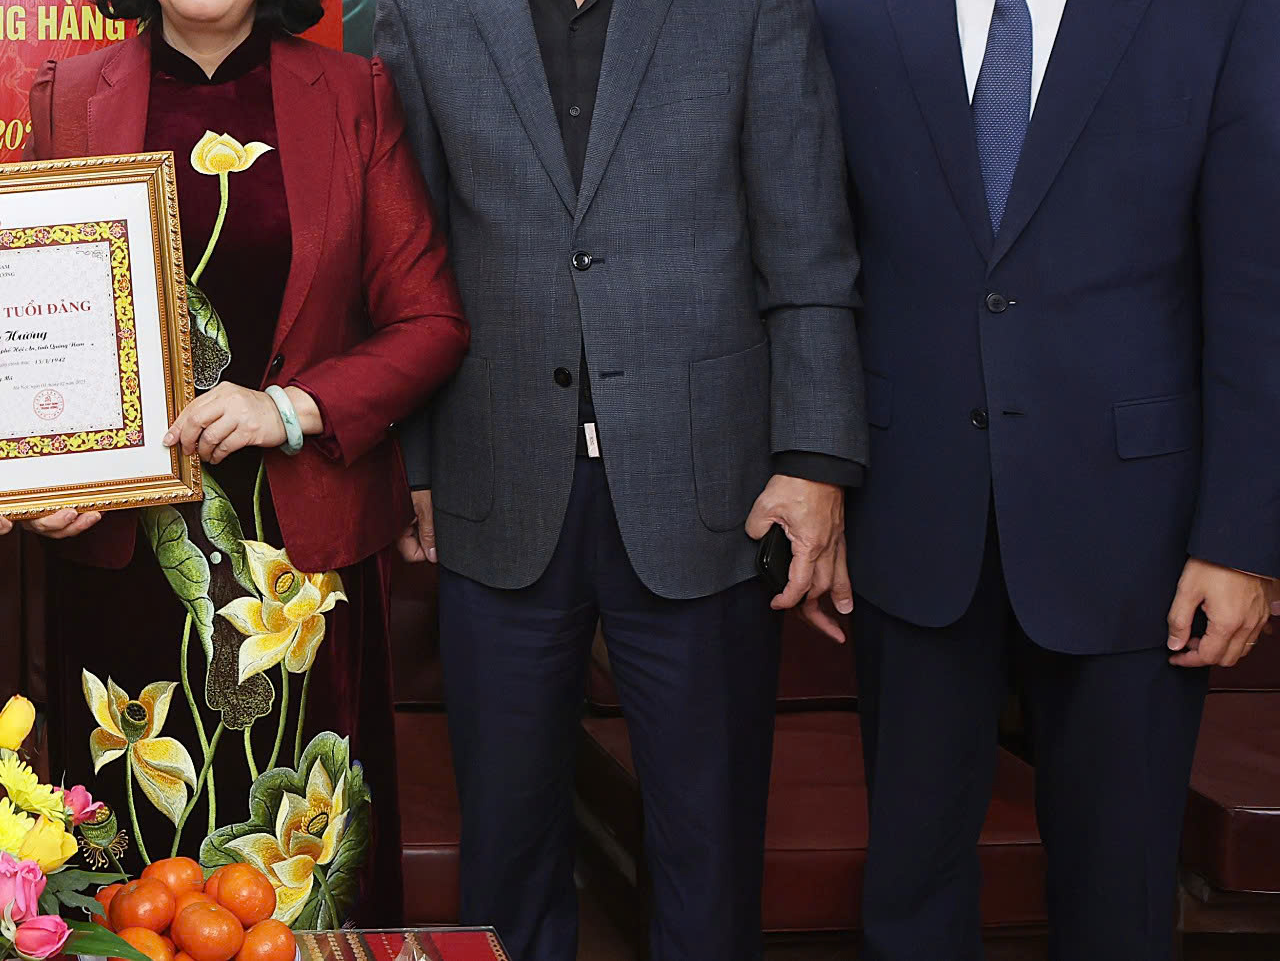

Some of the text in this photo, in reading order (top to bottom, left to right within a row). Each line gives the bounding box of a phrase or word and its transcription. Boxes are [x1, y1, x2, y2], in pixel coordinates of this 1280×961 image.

[4, 300, 43, 318] TUỔI
[47, 298, 91, 315] ĐẢNG
[5, 330, 48, 341] Hương
